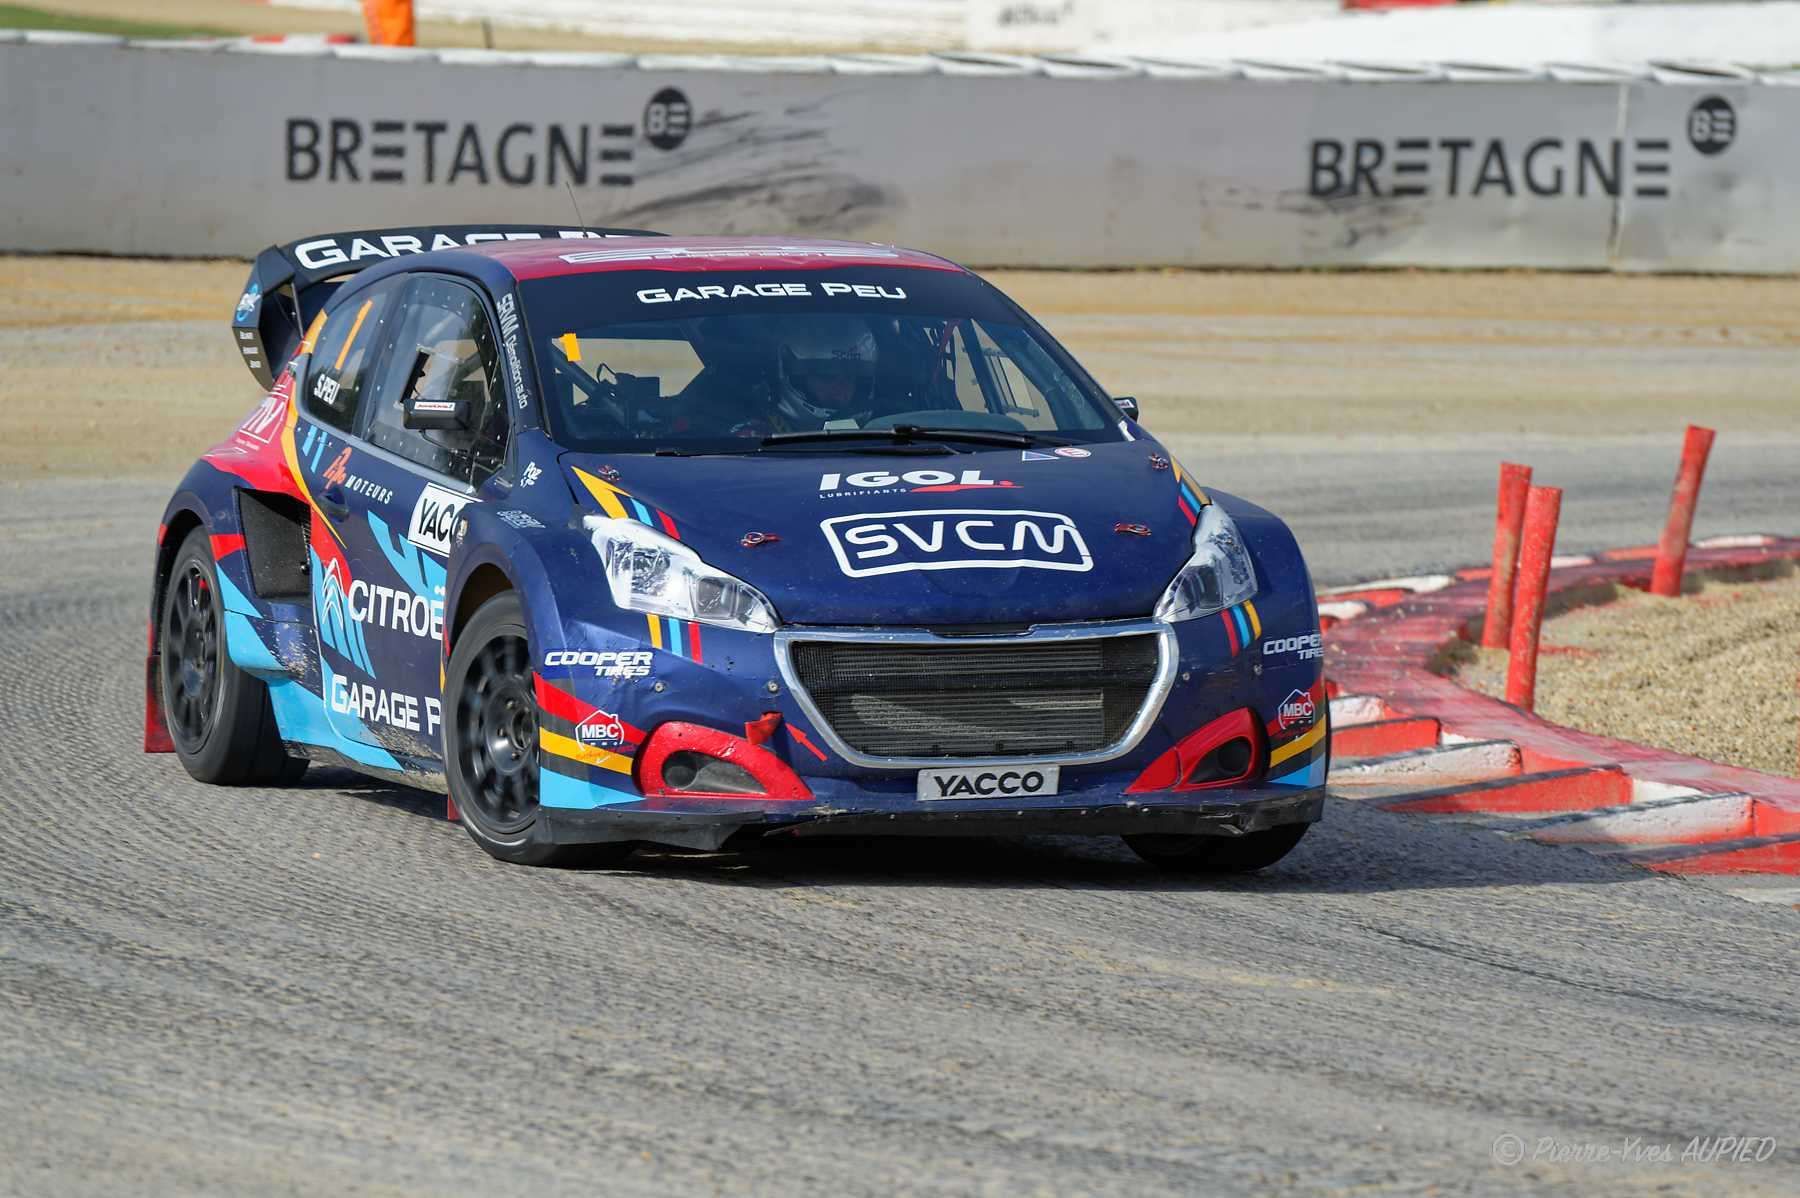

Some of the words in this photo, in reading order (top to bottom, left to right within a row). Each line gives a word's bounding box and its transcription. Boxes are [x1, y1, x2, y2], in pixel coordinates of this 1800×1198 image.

[285, 118, 635, 187] BRETAGNE
[1309, 138, 1670, 197] BRETAGNE
[295, 232, 541, 269] GARA
[636, 283, 812, 303] GARAGE
[820, 282, 906, 299] PEU
[345, 474, 393, 505] MOTEURS
[819, 488, 906, 499] LUBRIFIANTS
[845, 520, 1092, 559] SVCM
[348, 579, 445, 641] CITROË
[1263, 634, 1321, 655] COOPE
[544, 651, 653, 666] COOPER
[594, 665, 651, 677] TIRES
[331, 673, 420, 732] GARAGE
[424, 696, 441, 736] P
[1283, 702, 1312, 717] MBC
[581, 723, 619, 738] MBC
[933, 771, 1044, 797] YACCO
